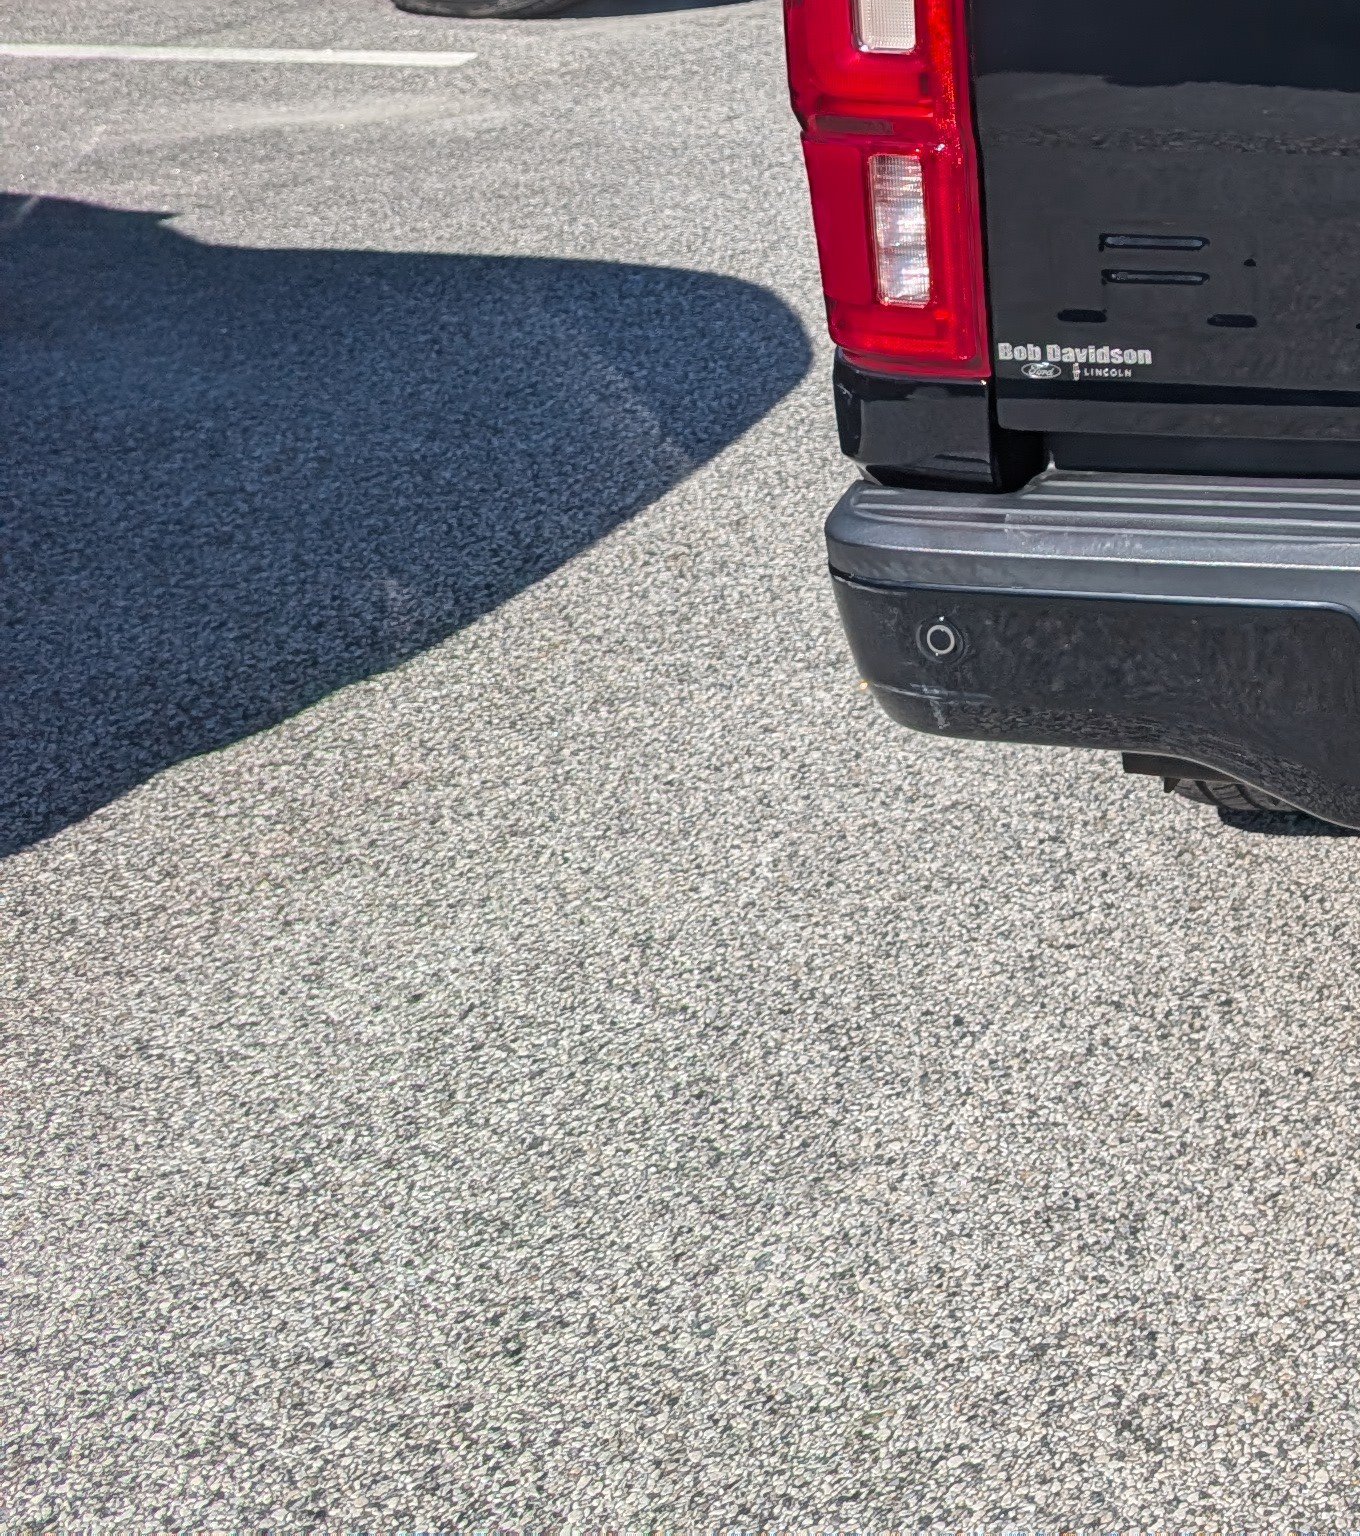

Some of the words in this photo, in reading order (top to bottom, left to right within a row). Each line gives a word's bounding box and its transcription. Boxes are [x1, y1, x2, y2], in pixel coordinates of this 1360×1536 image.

[998, 343, 1042, 361] Bob
[1046, 344, 1152, 365] Davidson
[1027, 363, 1056, 378] Ford
[1083, 367, 1132, 378] LINCOLN
